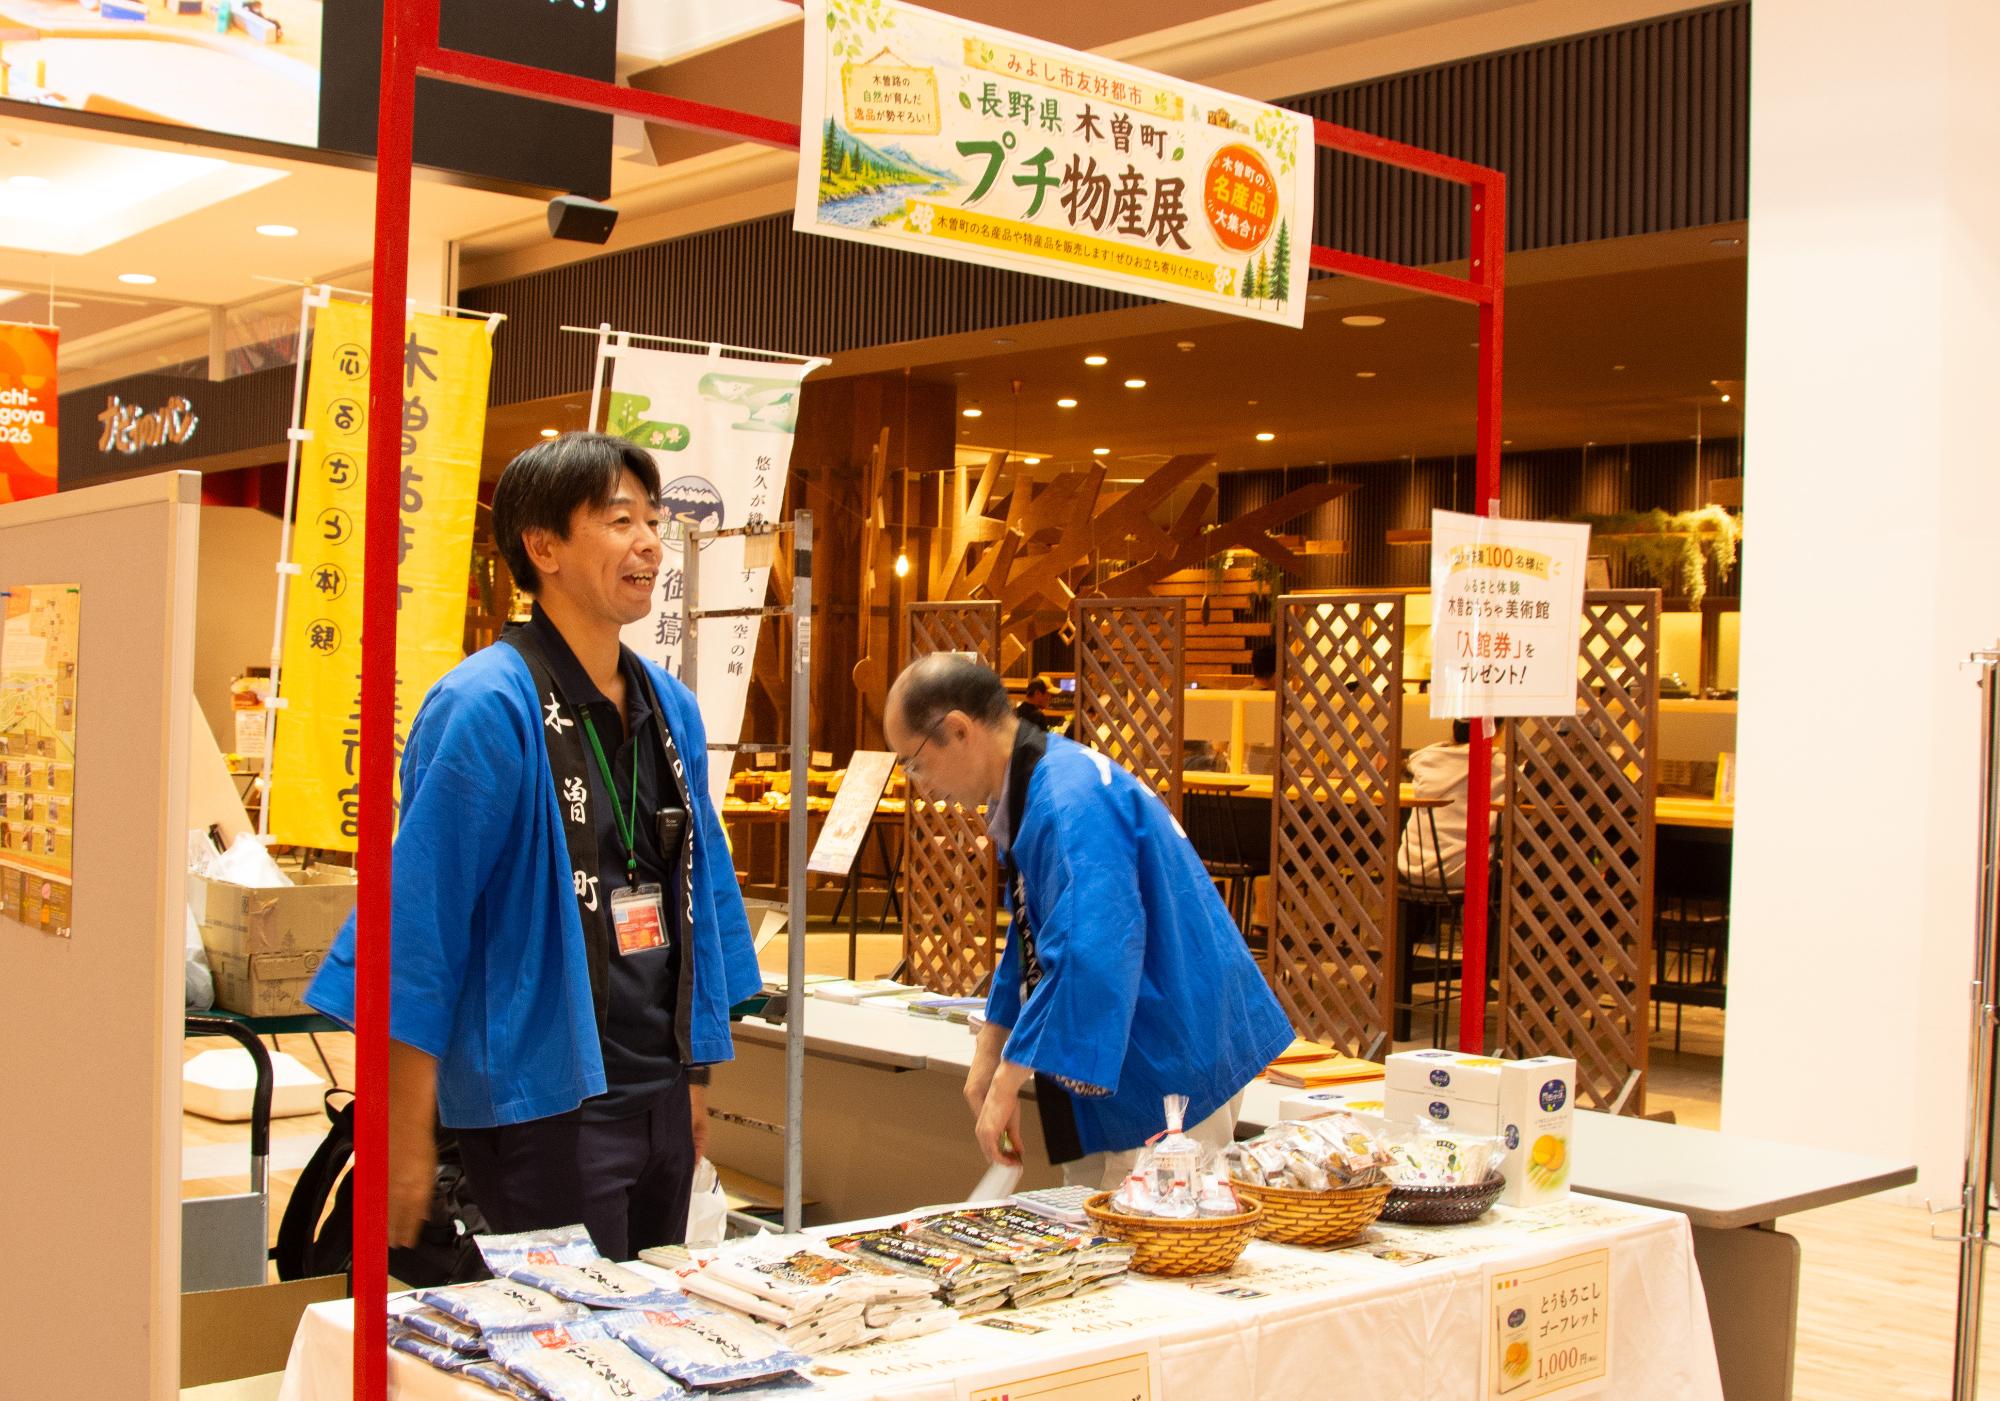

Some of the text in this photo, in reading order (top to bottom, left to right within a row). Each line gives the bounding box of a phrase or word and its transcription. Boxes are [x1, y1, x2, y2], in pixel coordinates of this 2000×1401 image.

[873, 74, 911, 87] 木曽路の
[1007, 54, 1142, 105] みよし市友好都市
[863, 89, 922, 105] 自然が育んだ
[977, 82, 1169, 160] 長野県 木曽町
[1221, 156, 1266, 187] 木曽町の
[955, 131, 1192, 250] プチ物産展
[1212, 174, 1267, 219] 名産品
[1540, 1282, 1601, 1314] とうもろこし
[1539, 1307, 1599, 1338] ゴーフレット
